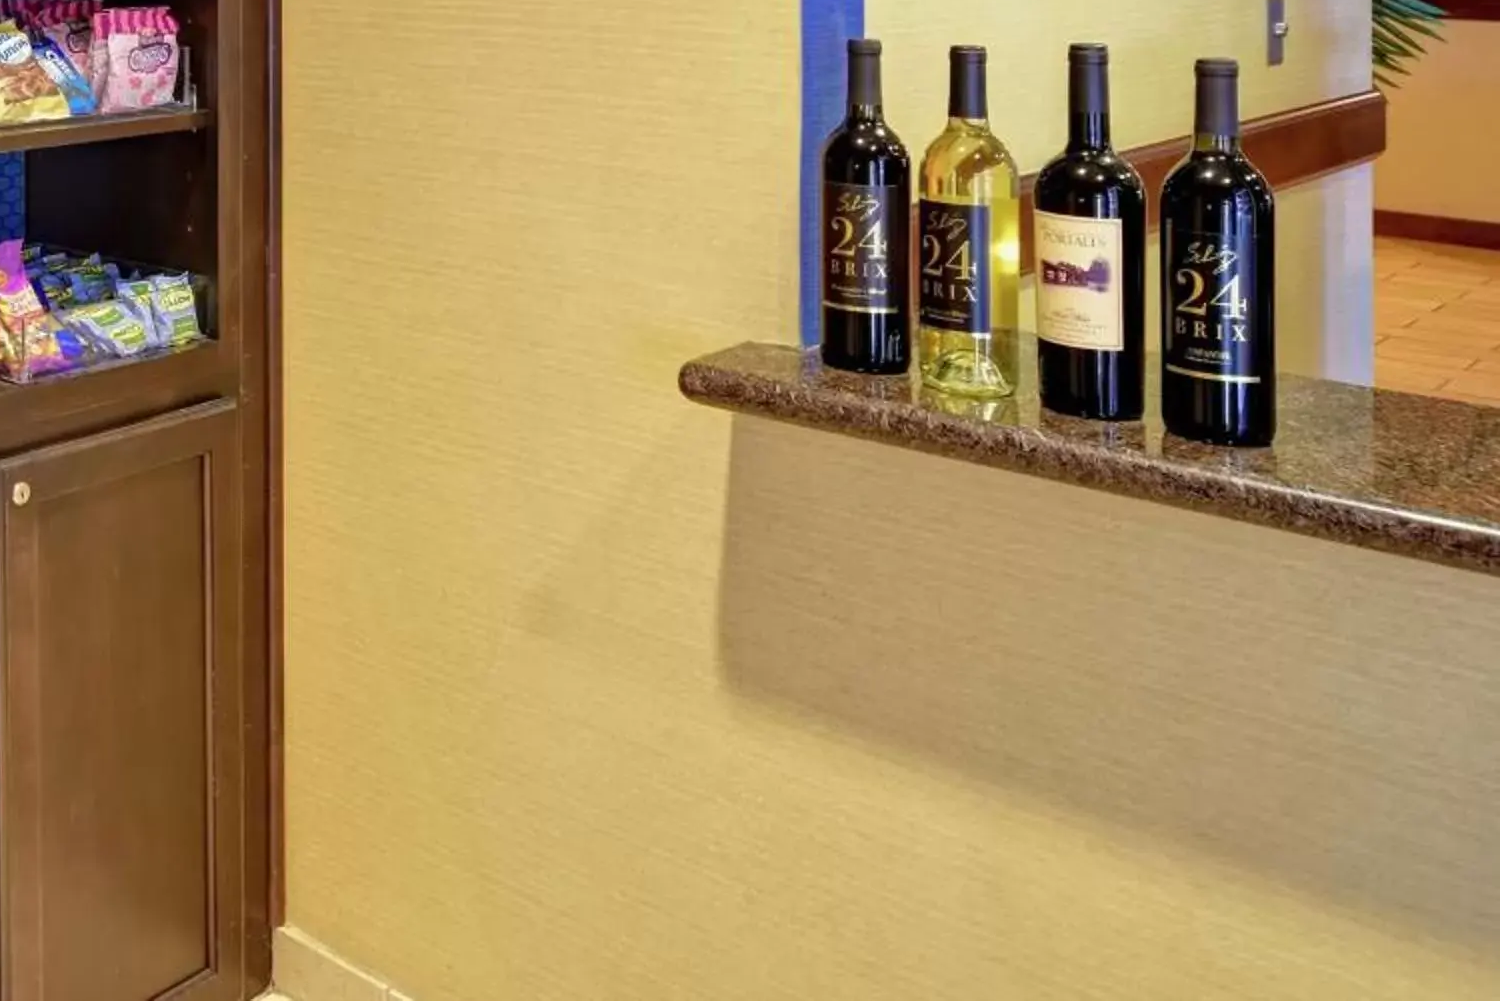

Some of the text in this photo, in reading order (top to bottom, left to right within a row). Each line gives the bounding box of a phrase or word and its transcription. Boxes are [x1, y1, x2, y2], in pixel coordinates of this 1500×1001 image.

[831, 216, 888, 260] 24
[830, 259, 888, 278] BRIX
[922, 234, 978, 280] 24
[923, 279, 978, 303] BRIX
[1175, 268, 1248, 320] 24
[1175, 316, 1248, 342] BRIX
